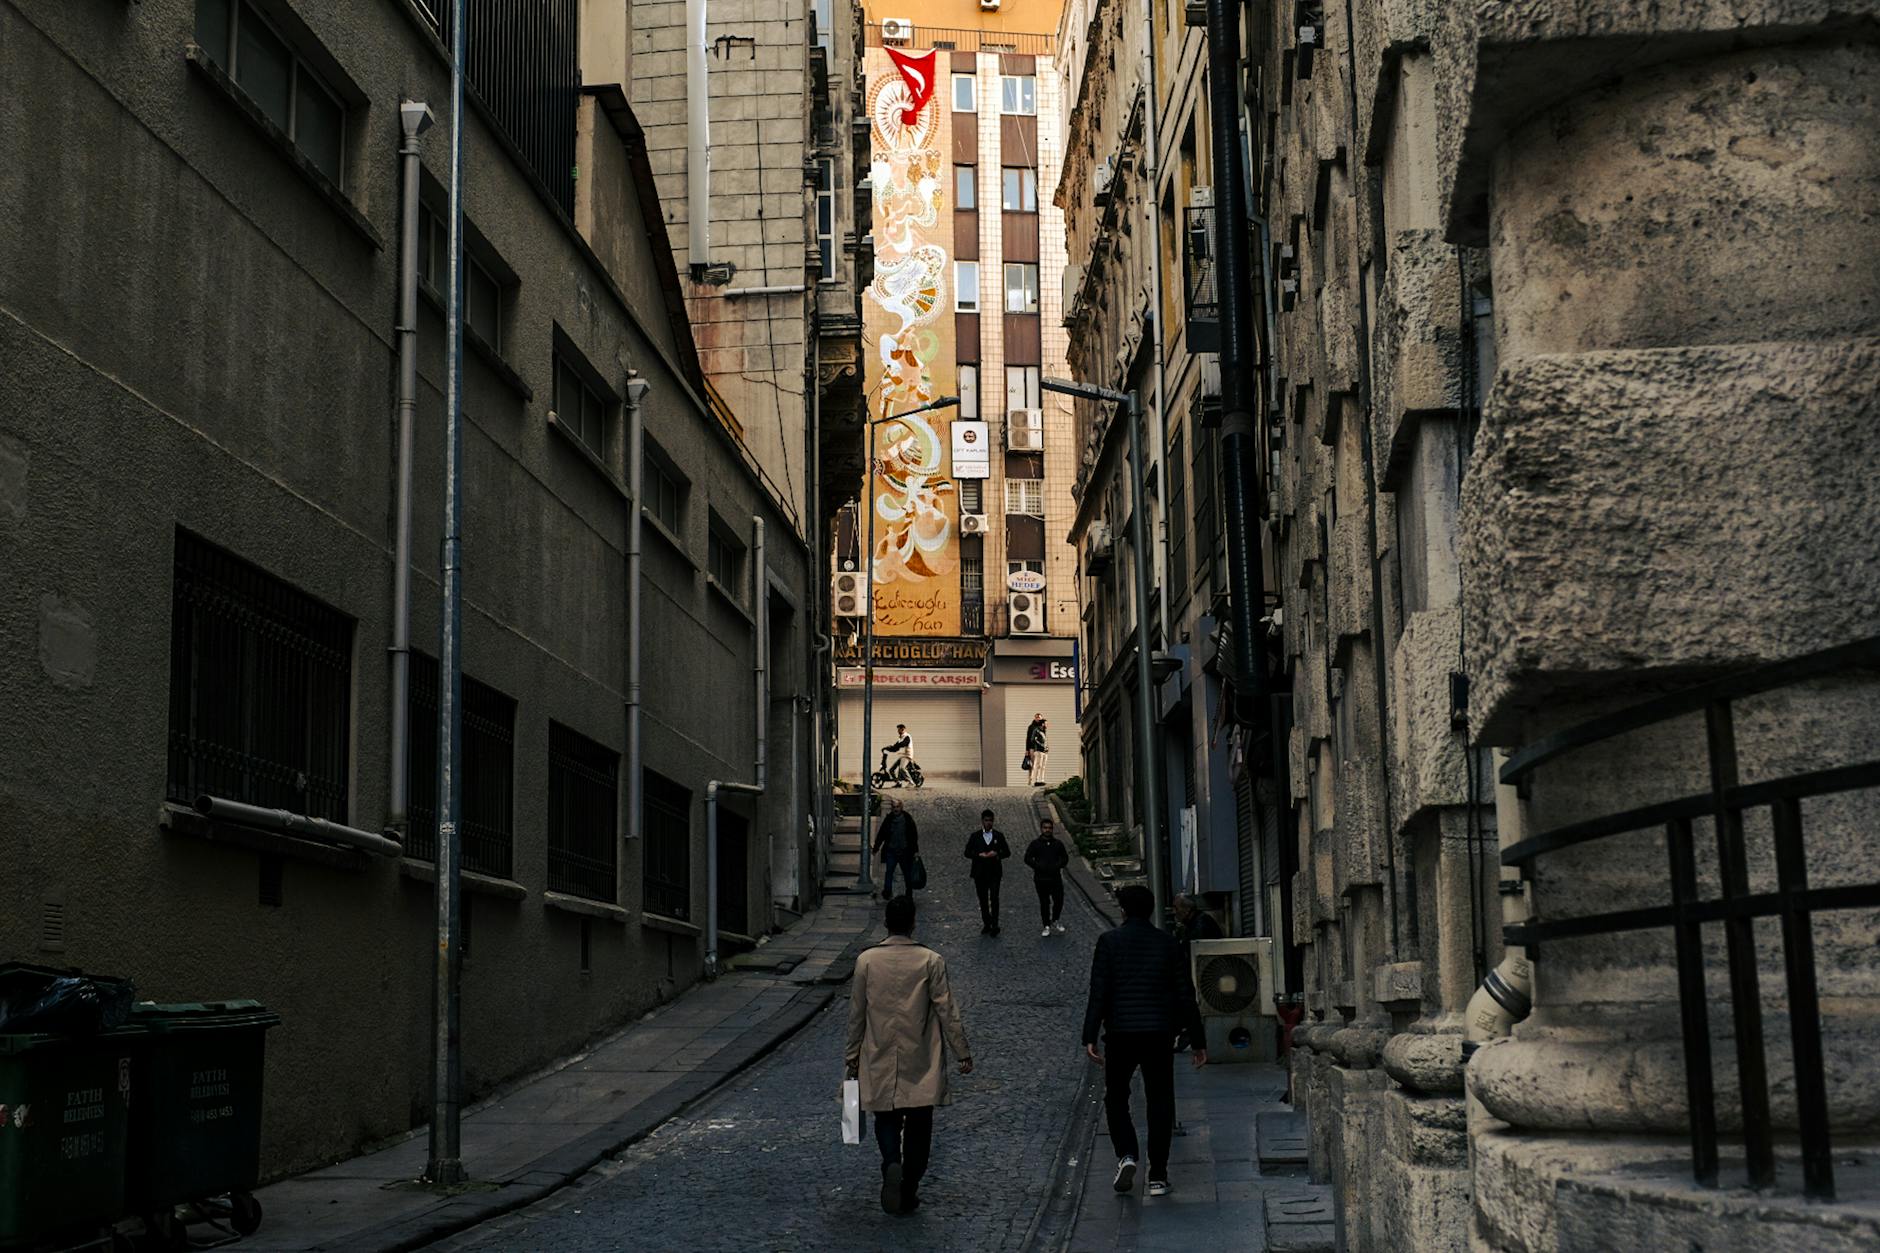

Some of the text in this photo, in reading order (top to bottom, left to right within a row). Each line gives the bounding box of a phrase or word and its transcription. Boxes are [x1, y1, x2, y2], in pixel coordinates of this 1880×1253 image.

[953, 645, 984, 659] HAN
[858, 673, 927, 684] PRDECİLER
[931, 675, 977, 686] ÇARŞISI
